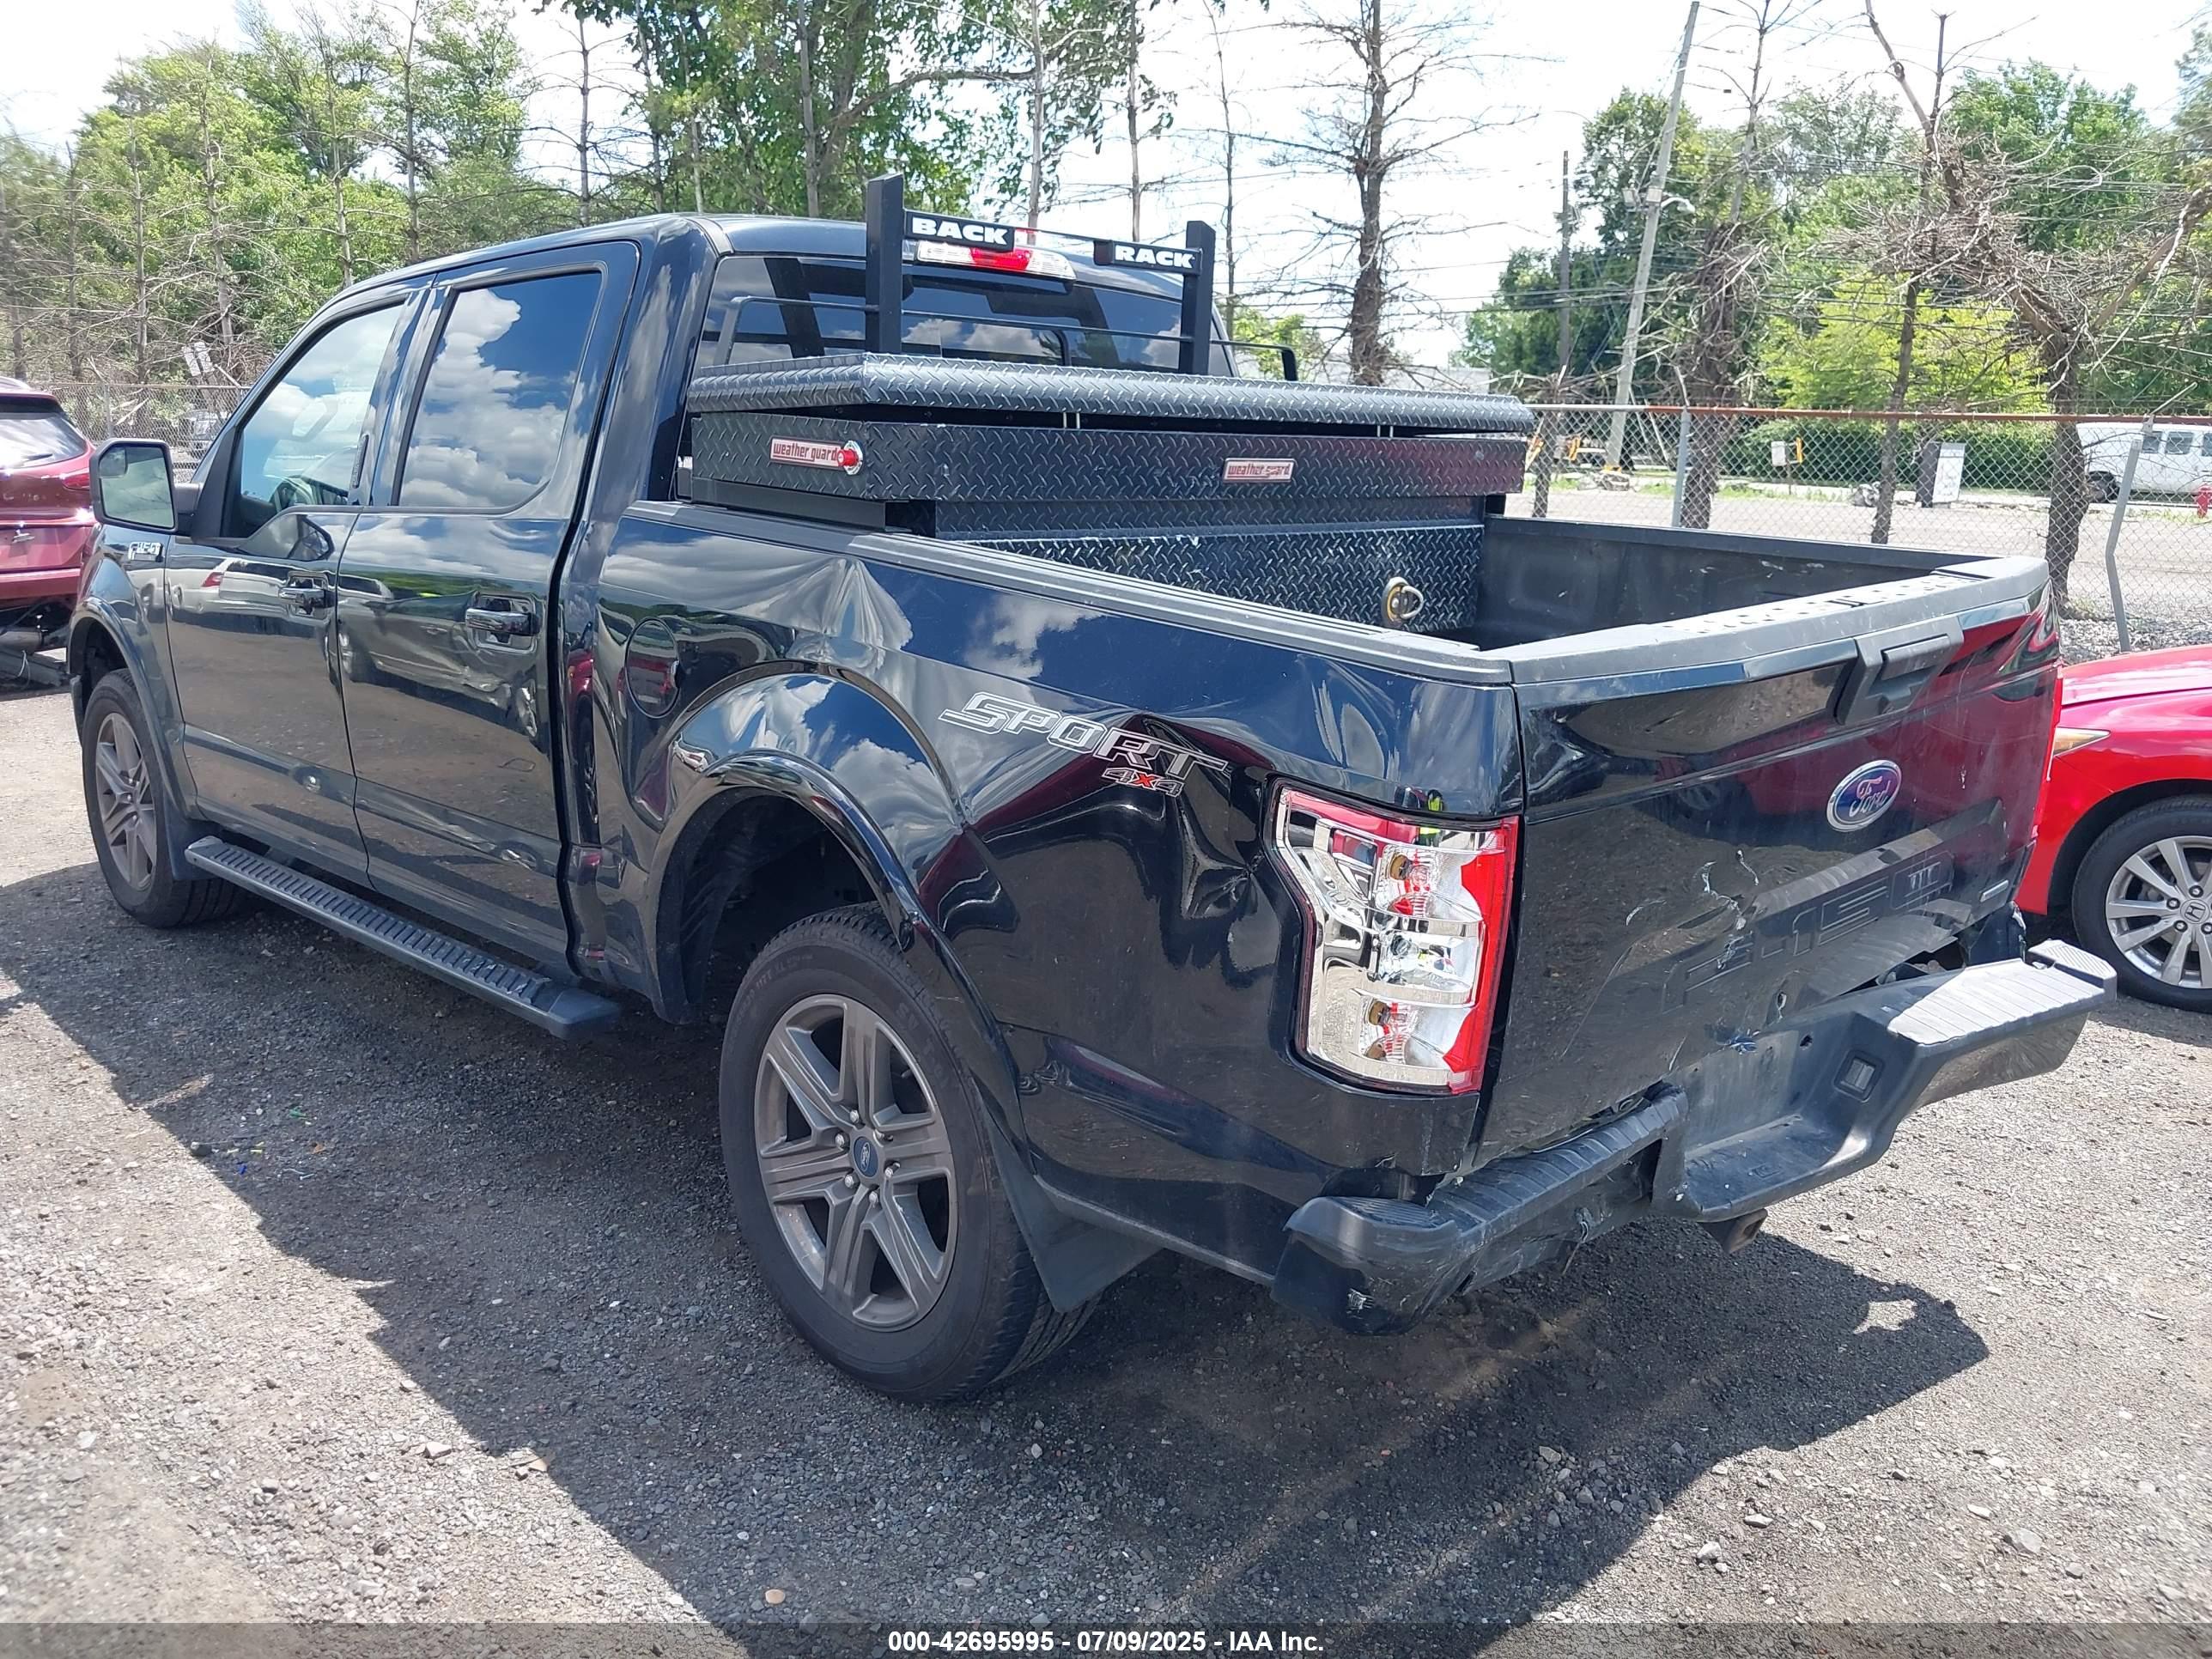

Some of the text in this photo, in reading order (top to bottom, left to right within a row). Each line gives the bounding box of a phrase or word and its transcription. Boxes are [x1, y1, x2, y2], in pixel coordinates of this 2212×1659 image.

[912, 217, 1011, 246] BACK
[1115, 245, 1194, 269] RACK
[774, 443, 811, 458] weather
[938, 691, 1229, 781] SPORT
[1849, 775, 1892, 817] Ford
